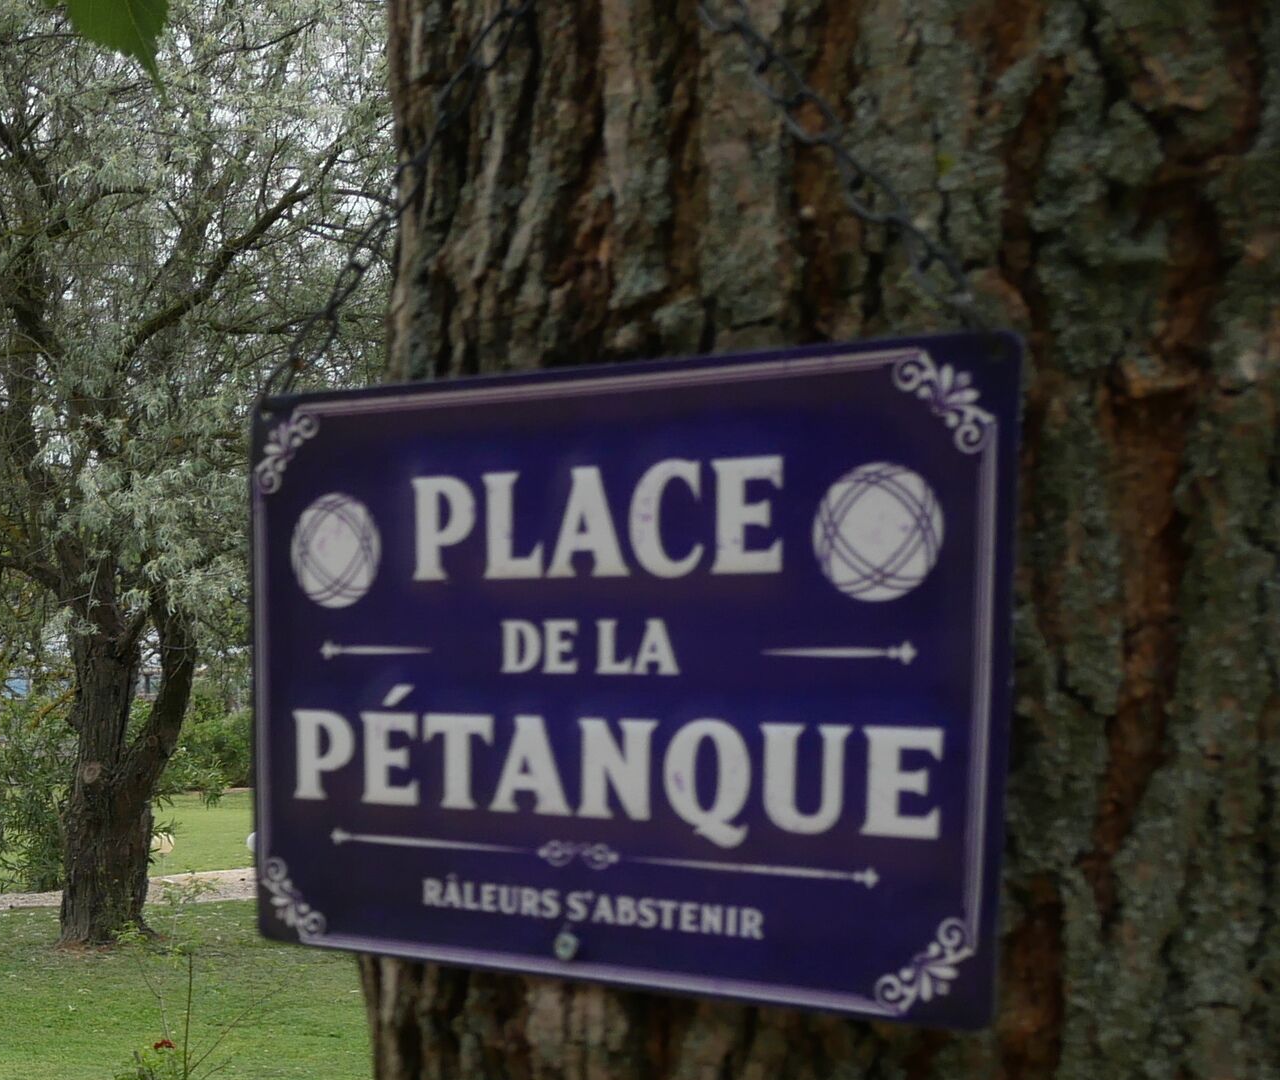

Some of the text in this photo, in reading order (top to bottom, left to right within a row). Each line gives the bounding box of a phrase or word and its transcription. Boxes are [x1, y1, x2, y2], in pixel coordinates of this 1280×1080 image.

[411, 454, 785, 582] PLACE
[500, 618, 681, 677] DE LA
[292, 684, 946, 849] PÉTANQUE
[422, 873, 766, 941] RÂLEURS S'ABSTENIR
